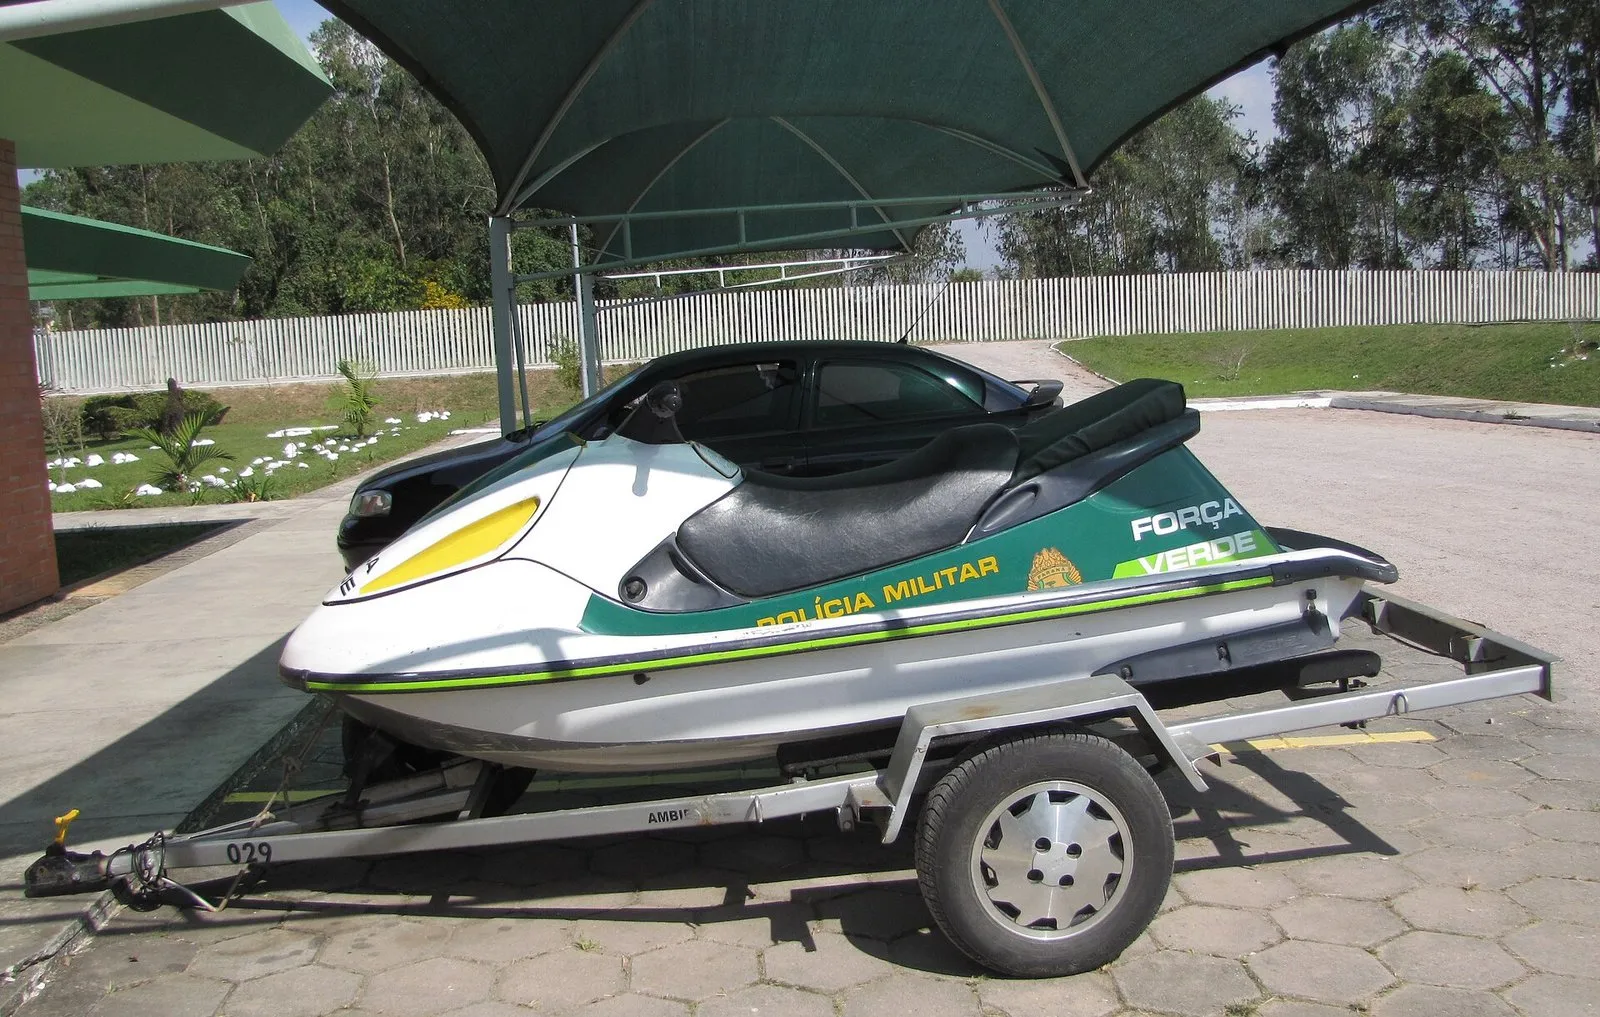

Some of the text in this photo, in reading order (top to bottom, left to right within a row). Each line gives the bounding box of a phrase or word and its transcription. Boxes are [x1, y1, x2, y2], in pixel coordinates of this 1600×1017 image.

[1131, 497, 1243, 541] FORÇA
[1138, 531, 1256, 575] VERDE
[883, 556, 999, 603] MILITAR
[227, 842, 272, 864] 029
